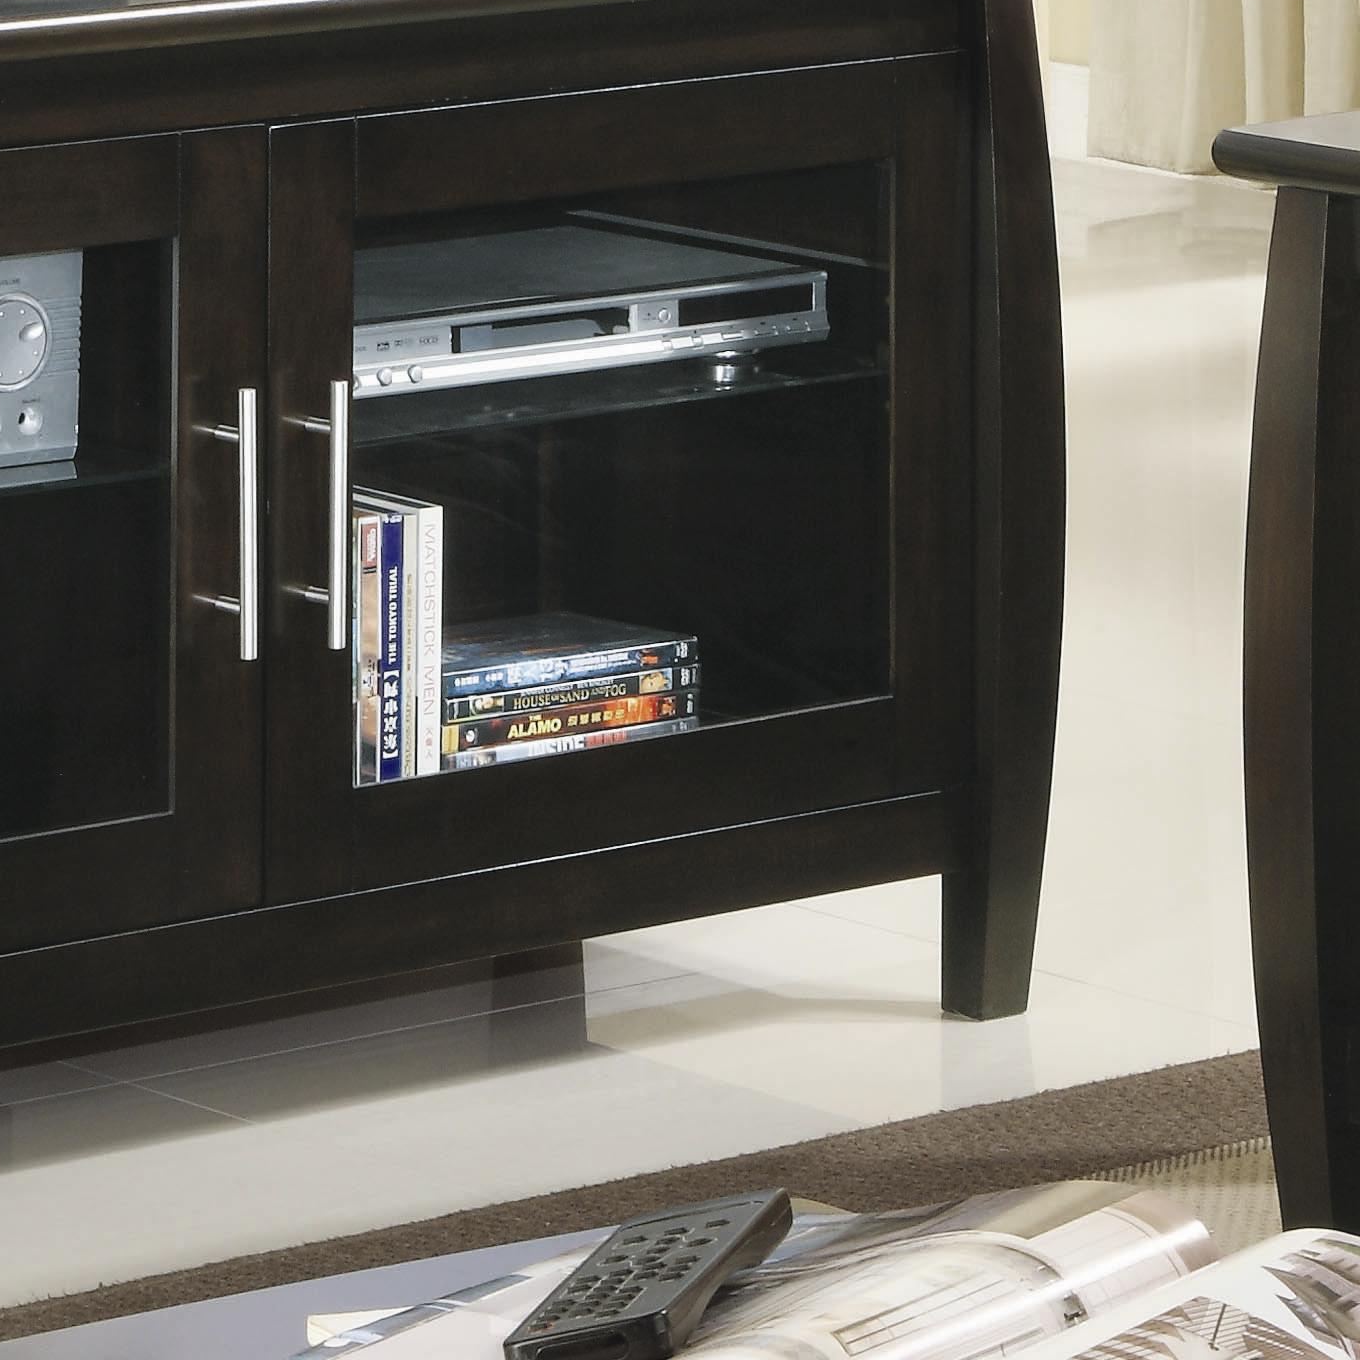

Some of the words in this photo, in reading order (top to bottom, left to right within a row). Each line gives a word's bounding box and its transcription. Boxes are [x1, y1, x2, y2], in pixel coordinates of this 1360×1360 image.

[389, 565, 398, 602] TRIAL
[424, 523, 437, 656] MATCHSTICK
[388, 604, 397, 641] TOKYO
[388, 642, 397, 666] THE
[423, 664, 435, 716] MEN
[513, 693, 551, 710] HOUSE
[559, 688, 590, 704] SAND
[604, 682, 627, 698] FOG
[507, 718, 562, 739] ALAMO
